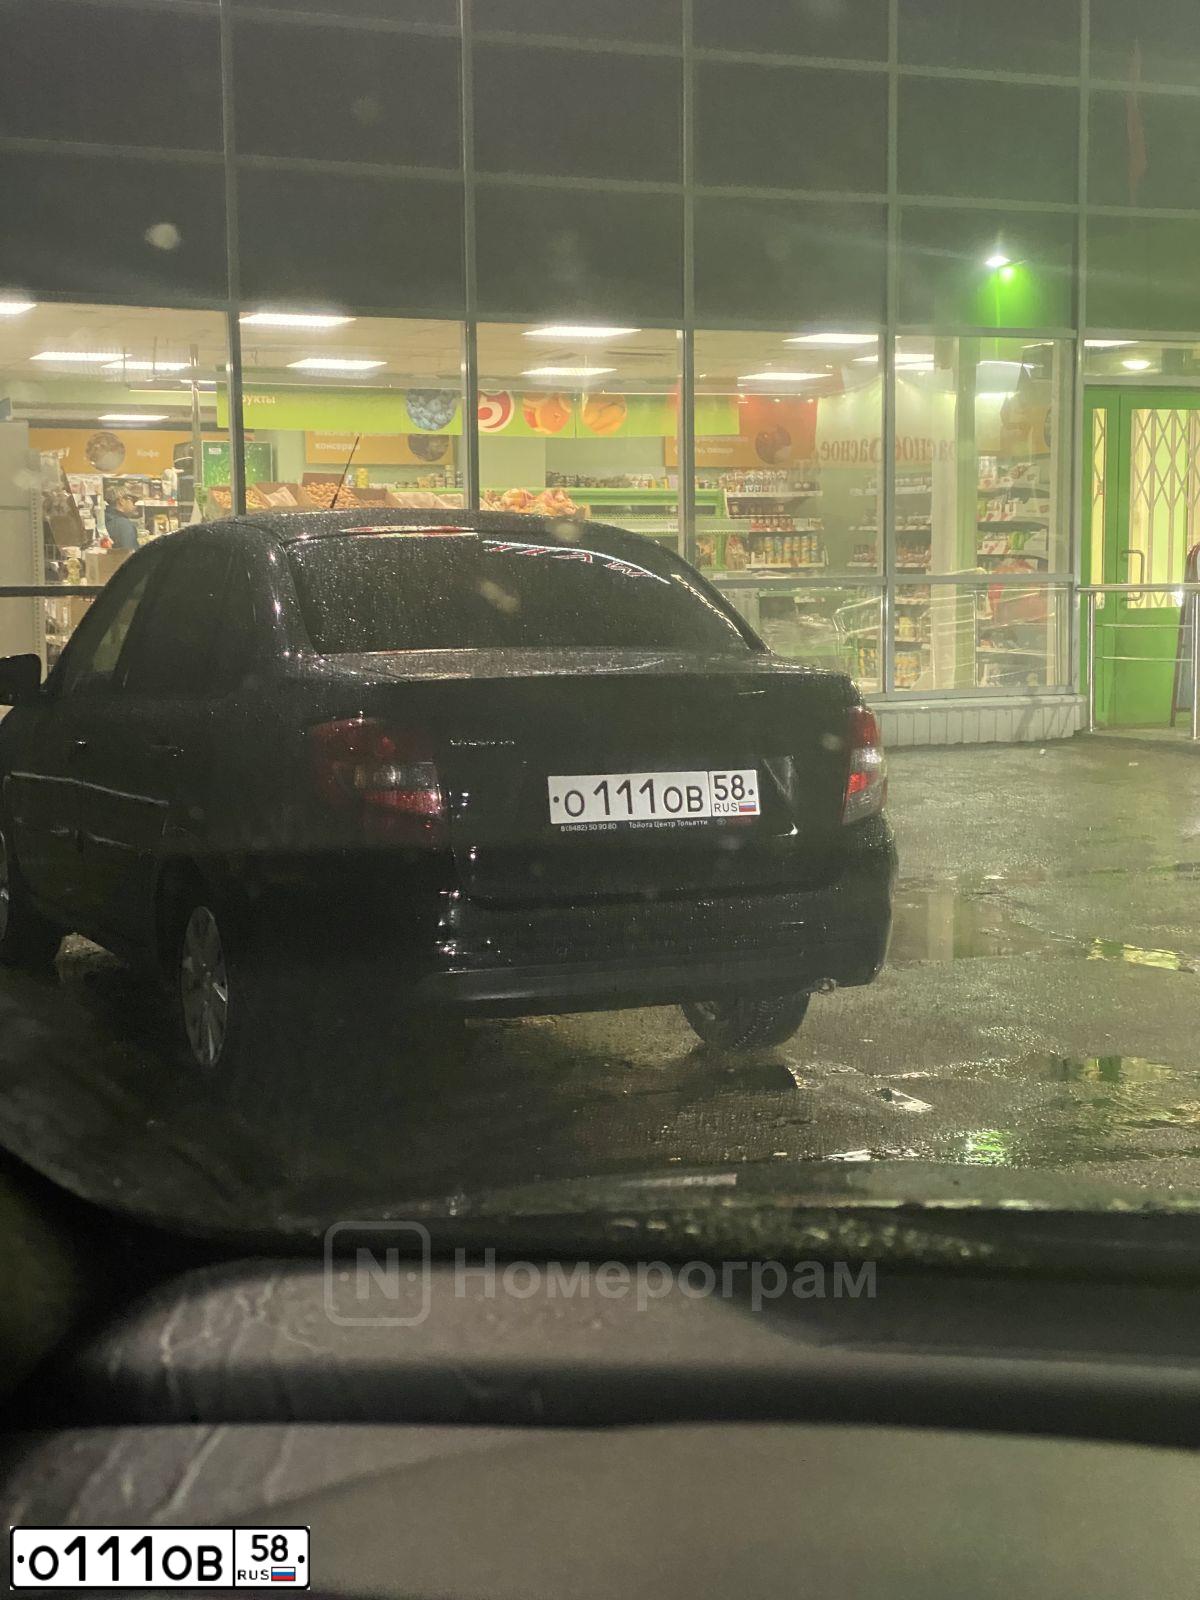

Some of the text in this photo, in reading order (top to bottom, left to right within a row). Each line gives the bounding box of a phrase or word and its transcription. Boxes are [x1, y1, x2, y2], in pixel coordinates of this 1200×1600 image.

[714, 774, 745, 801] 58
[714, 803, 738, 812] RUS
[629, 819, 709, 829] Тойота Центр Тольятти
